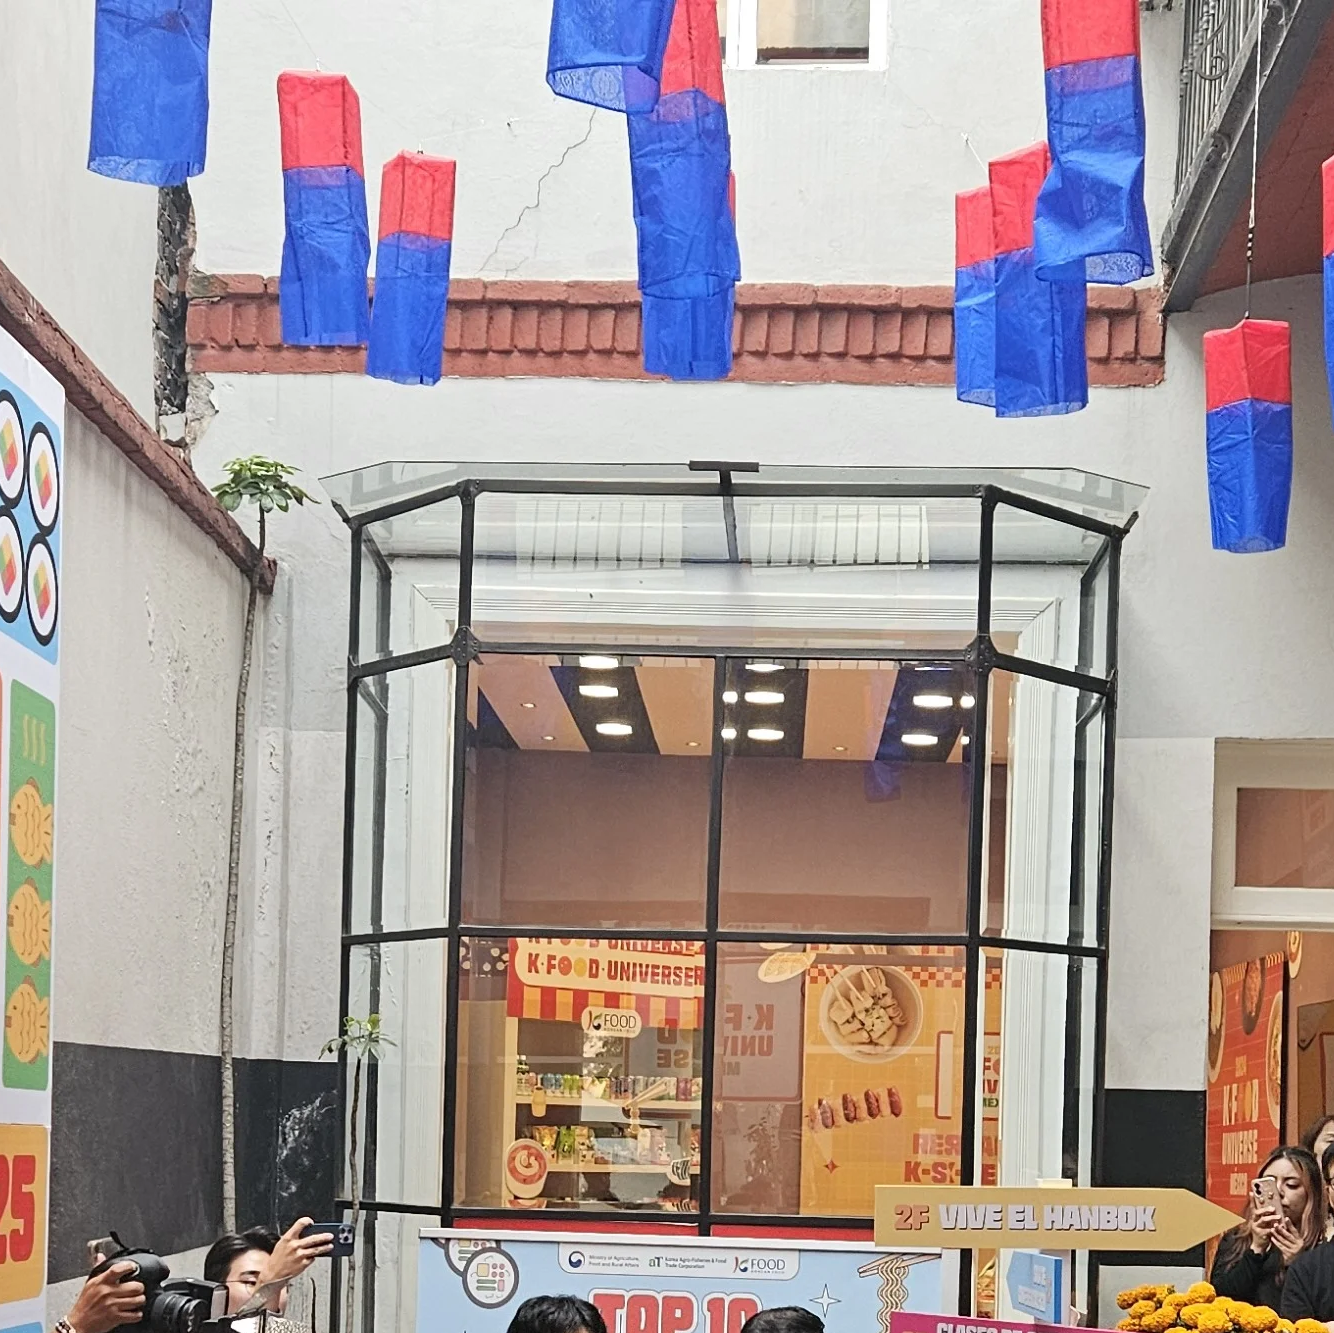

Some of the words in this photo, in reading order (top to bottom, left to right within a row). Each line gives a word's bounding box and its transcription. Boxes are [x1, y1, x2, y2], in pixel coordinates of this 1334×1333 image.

[603, 1013, 637, 1029] FOOD
[894, 1204, 930, 1231] 2F
[938, 1204, 1003, 1230] VIVE
[1008, 1204, 1039, 1230] EL
[1044, 1205, 1157, 1232] HANBOK
[751, 1258, 786, 1271] FOOD
